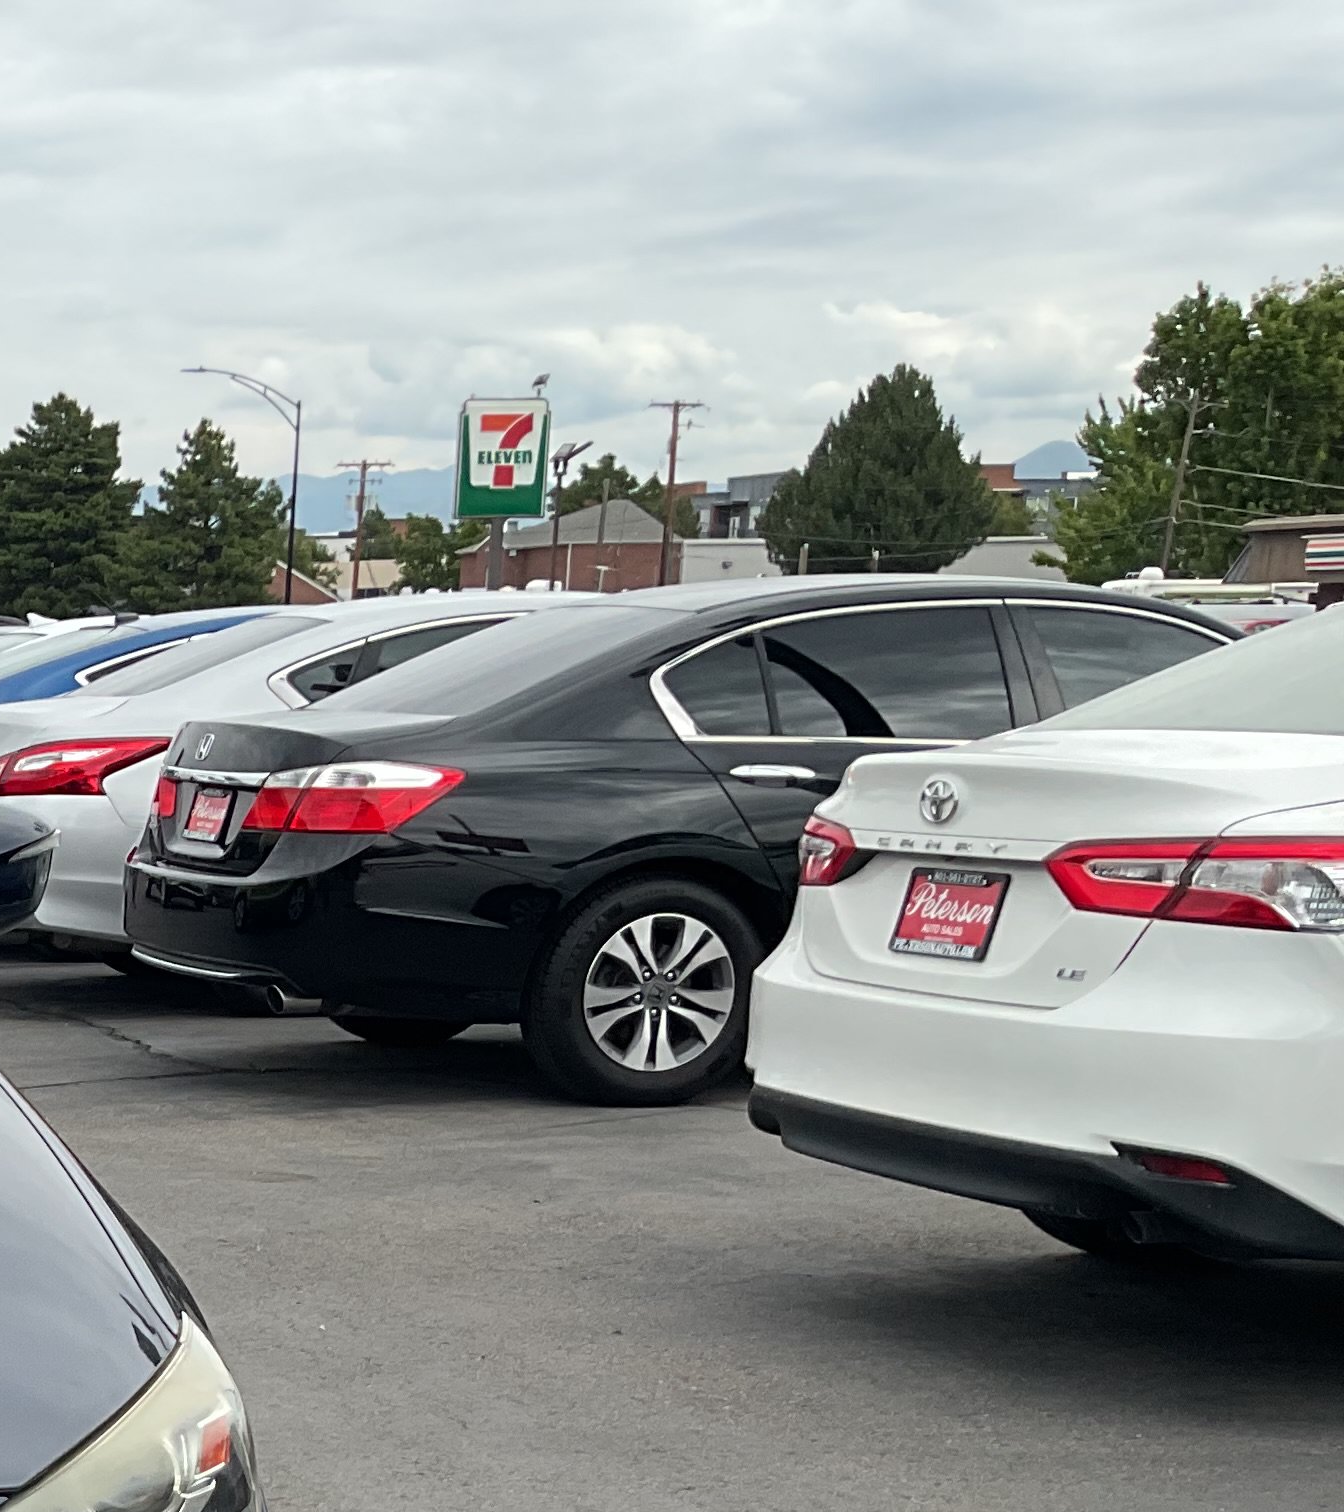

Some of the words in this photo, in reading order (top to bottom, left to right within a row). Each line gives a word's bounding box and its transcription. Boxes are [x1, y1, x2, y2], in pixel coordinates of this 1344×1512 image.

[480, 413, 534, 487] 7
[905, 882, 994, 925] Peterson
[1056, 967, 1087, 982] LE
